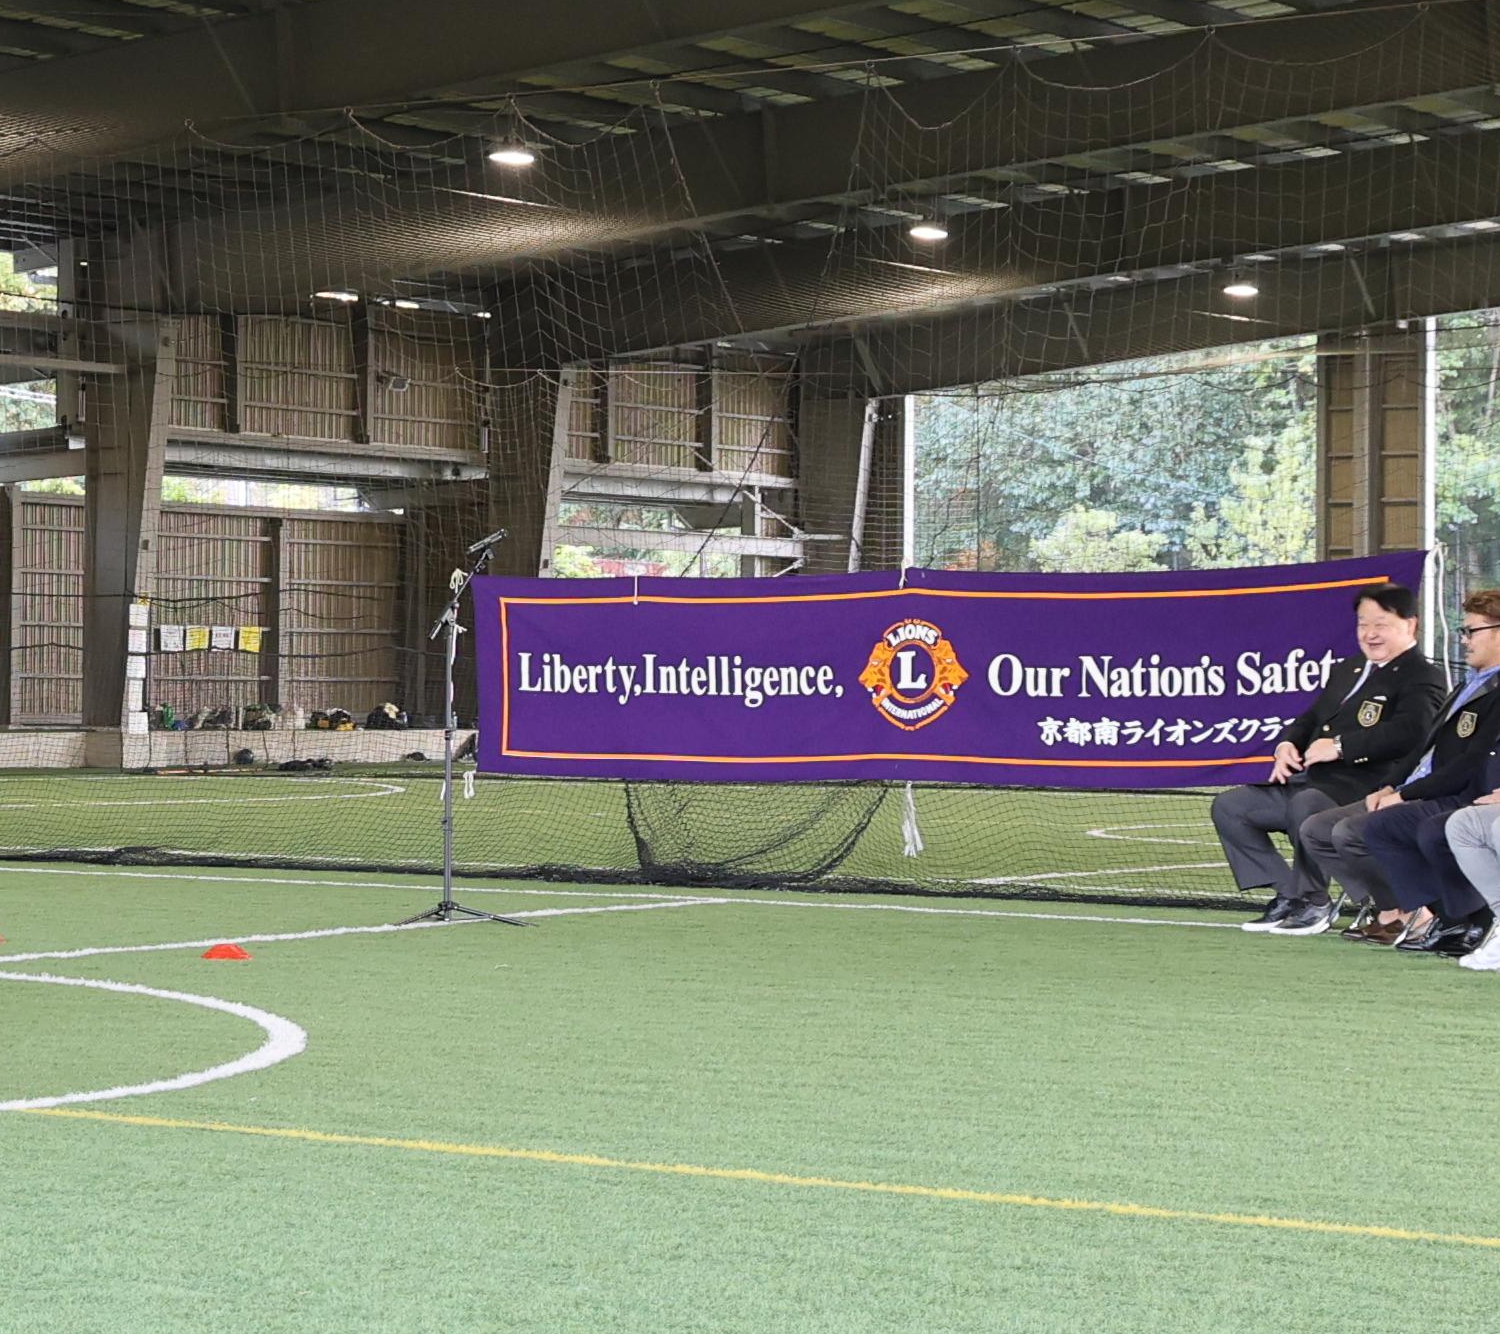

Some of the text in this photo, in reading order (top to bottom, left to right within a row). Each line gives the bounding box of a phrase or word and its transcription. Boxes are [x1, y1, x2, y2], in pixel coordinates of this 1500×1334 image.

[886, 623, 938, 647] LIONS
[896, 650, 928, 690] L
[987, 648, 1345, 698] Our Nation's Safet
[1036, 716, 1297, 747] 京都南ライオンズクラ
